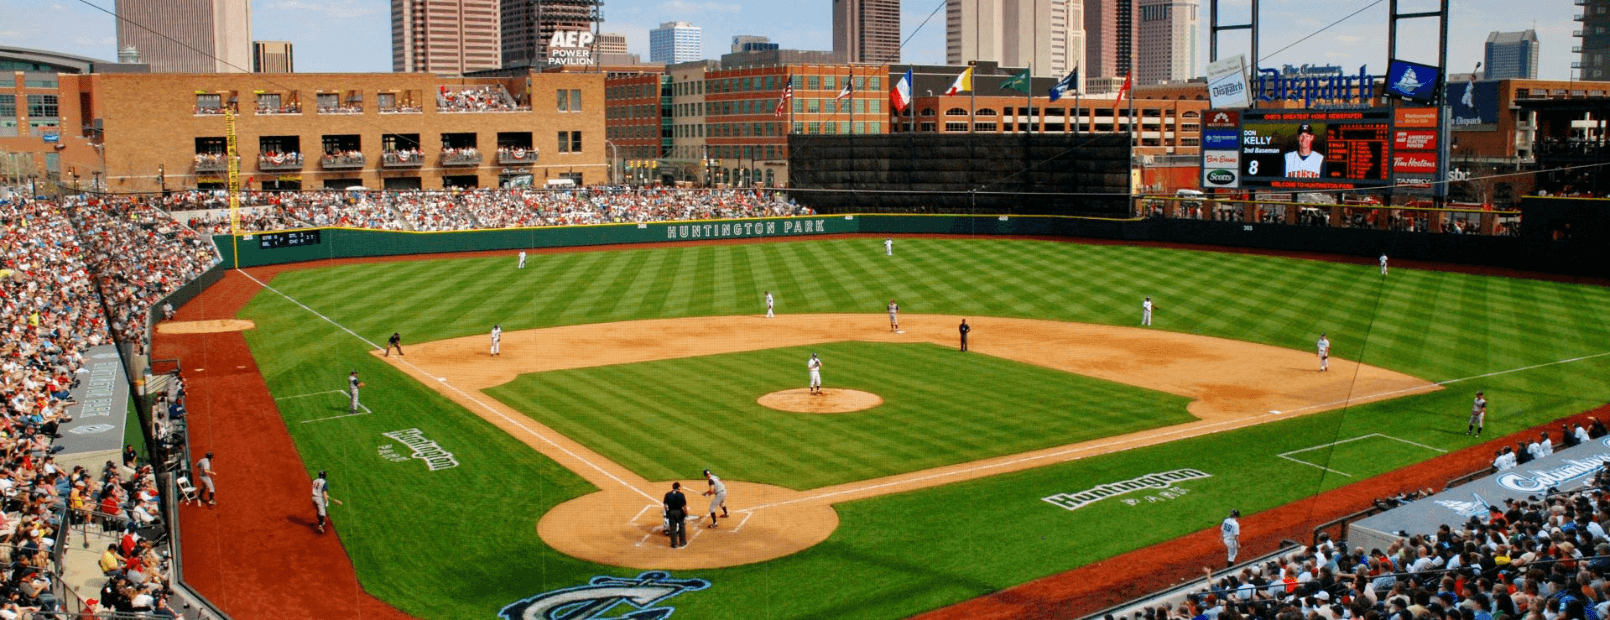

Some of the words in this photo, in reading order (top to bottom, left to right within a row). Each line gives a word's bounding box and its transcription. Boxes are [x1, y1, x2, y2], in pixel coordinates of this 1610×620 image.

[550, 30, 594, 48] AEP
[552, 49, 590, 57] POWER
[548, 57, 594, 65] PAVILION
[1283, 64, 1299, 74] The
[1212, 81, 1244, 98] Dispatch
[1257, 64, 1374, 107] Dispatch
[1243, 136, 1272, 145] KELLY
[1206, 155, 1219, 163] Bob
[1219, 155, 1237, 163] Evans
[1393, 157, 1407, 167] Tim
[1407, 157, 1436, 167] Hortons
[1249, 160, 1259, 175] 8
[1209, 172, 1233, 181] Scotts
[667, 221, 776, 239] HUNTINGTON
[783, 219, 825, 233] PARK
[382, 427, 459, 471] Huntington
[1041, 468, 1213, 510] Huntington
